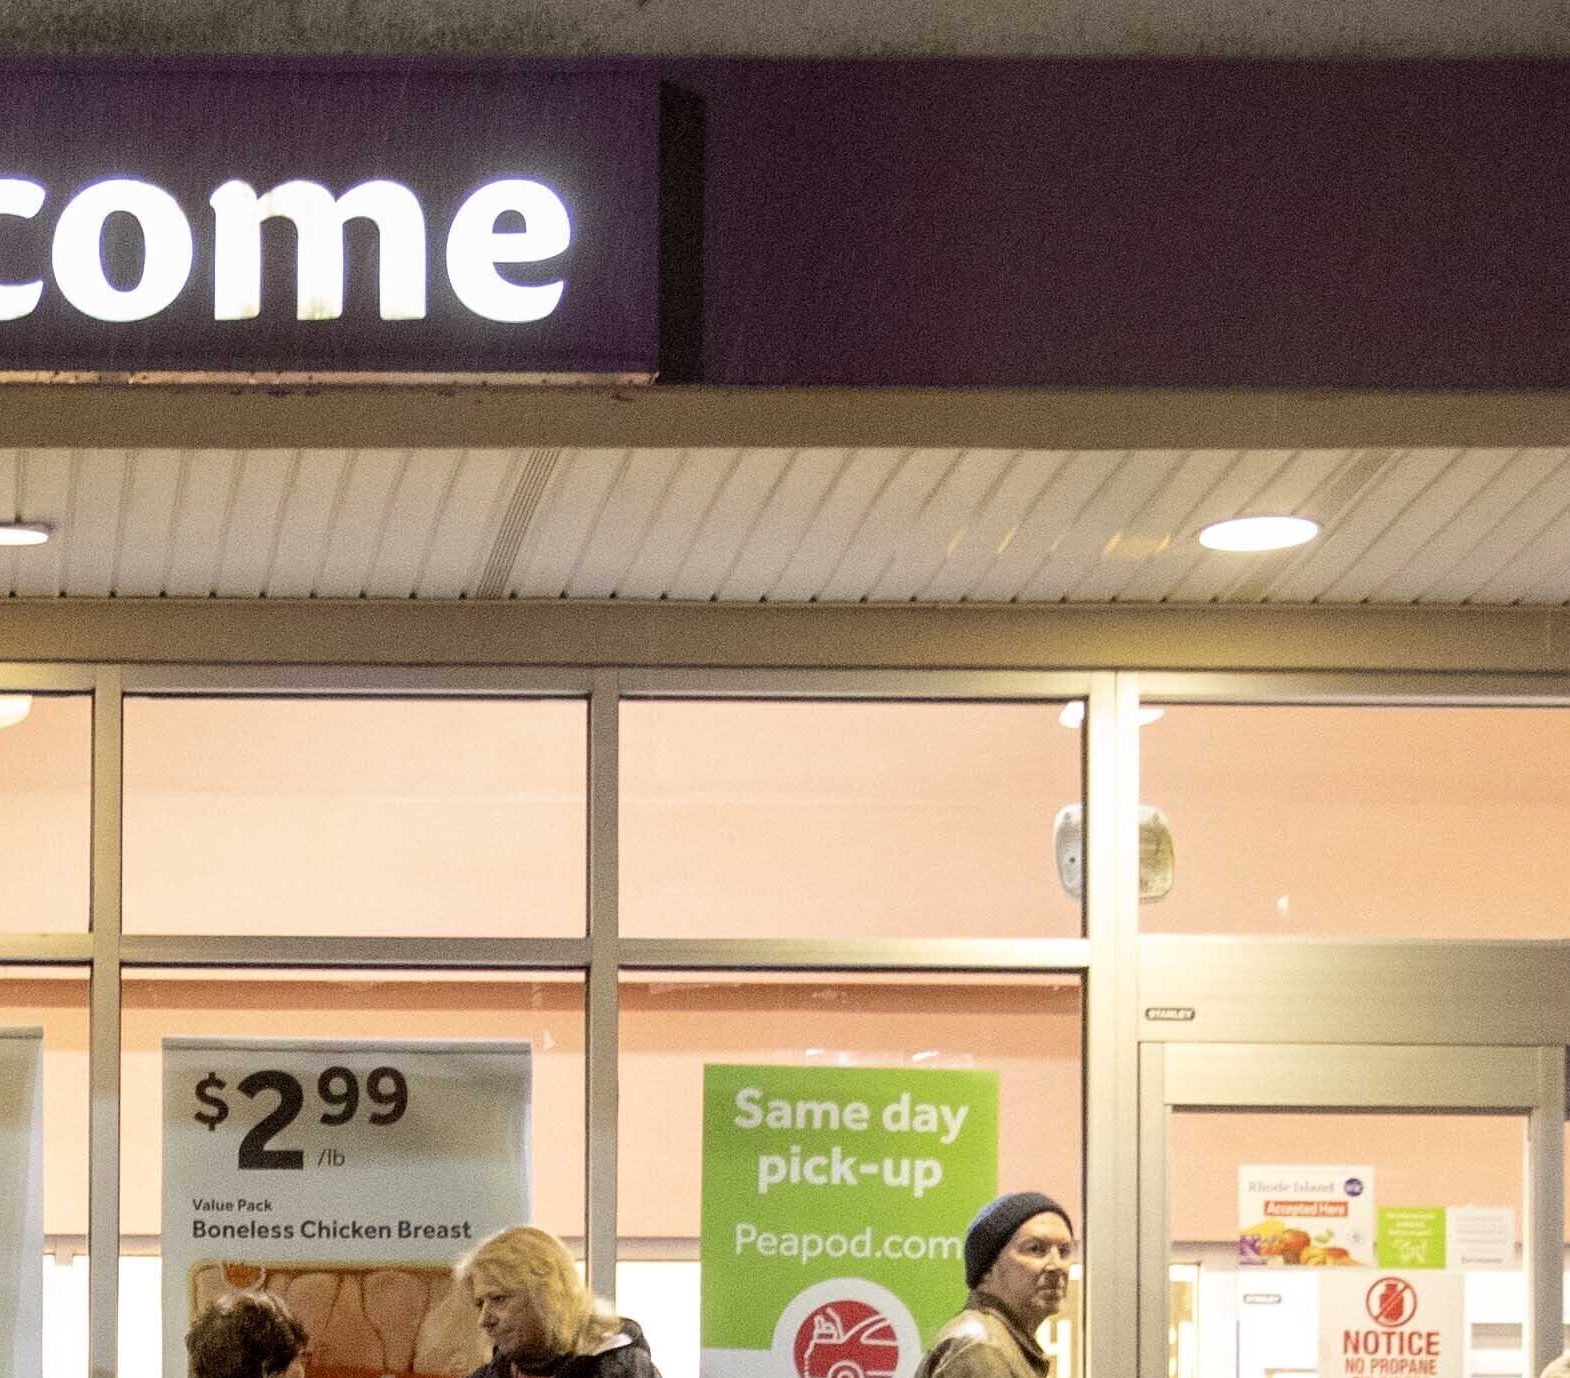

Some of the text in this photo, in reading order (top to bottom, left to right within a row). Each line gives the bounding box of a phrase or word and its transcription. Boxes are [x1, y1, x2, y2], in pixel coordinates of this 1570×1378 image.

[735, 1087, 969, 1144] Same day
[317, 1148, 346, 1168] /lb
[758, 1145, 943, 1199] pick-up
[1248, 1181, 1291, 1193] Rhode
[1293, 1181, 1335, 1193] Island
[193, 1199, 273, 1212] Value Pack
[193, 1220, 472, 1239] Boneless Chicken Breast
[735, 1223, 963, 1265] Peapod.com
[1343, 1330, 1440, 1355] NOTICE
[1345, 1358, 1438, 1375] NO PROPANE
